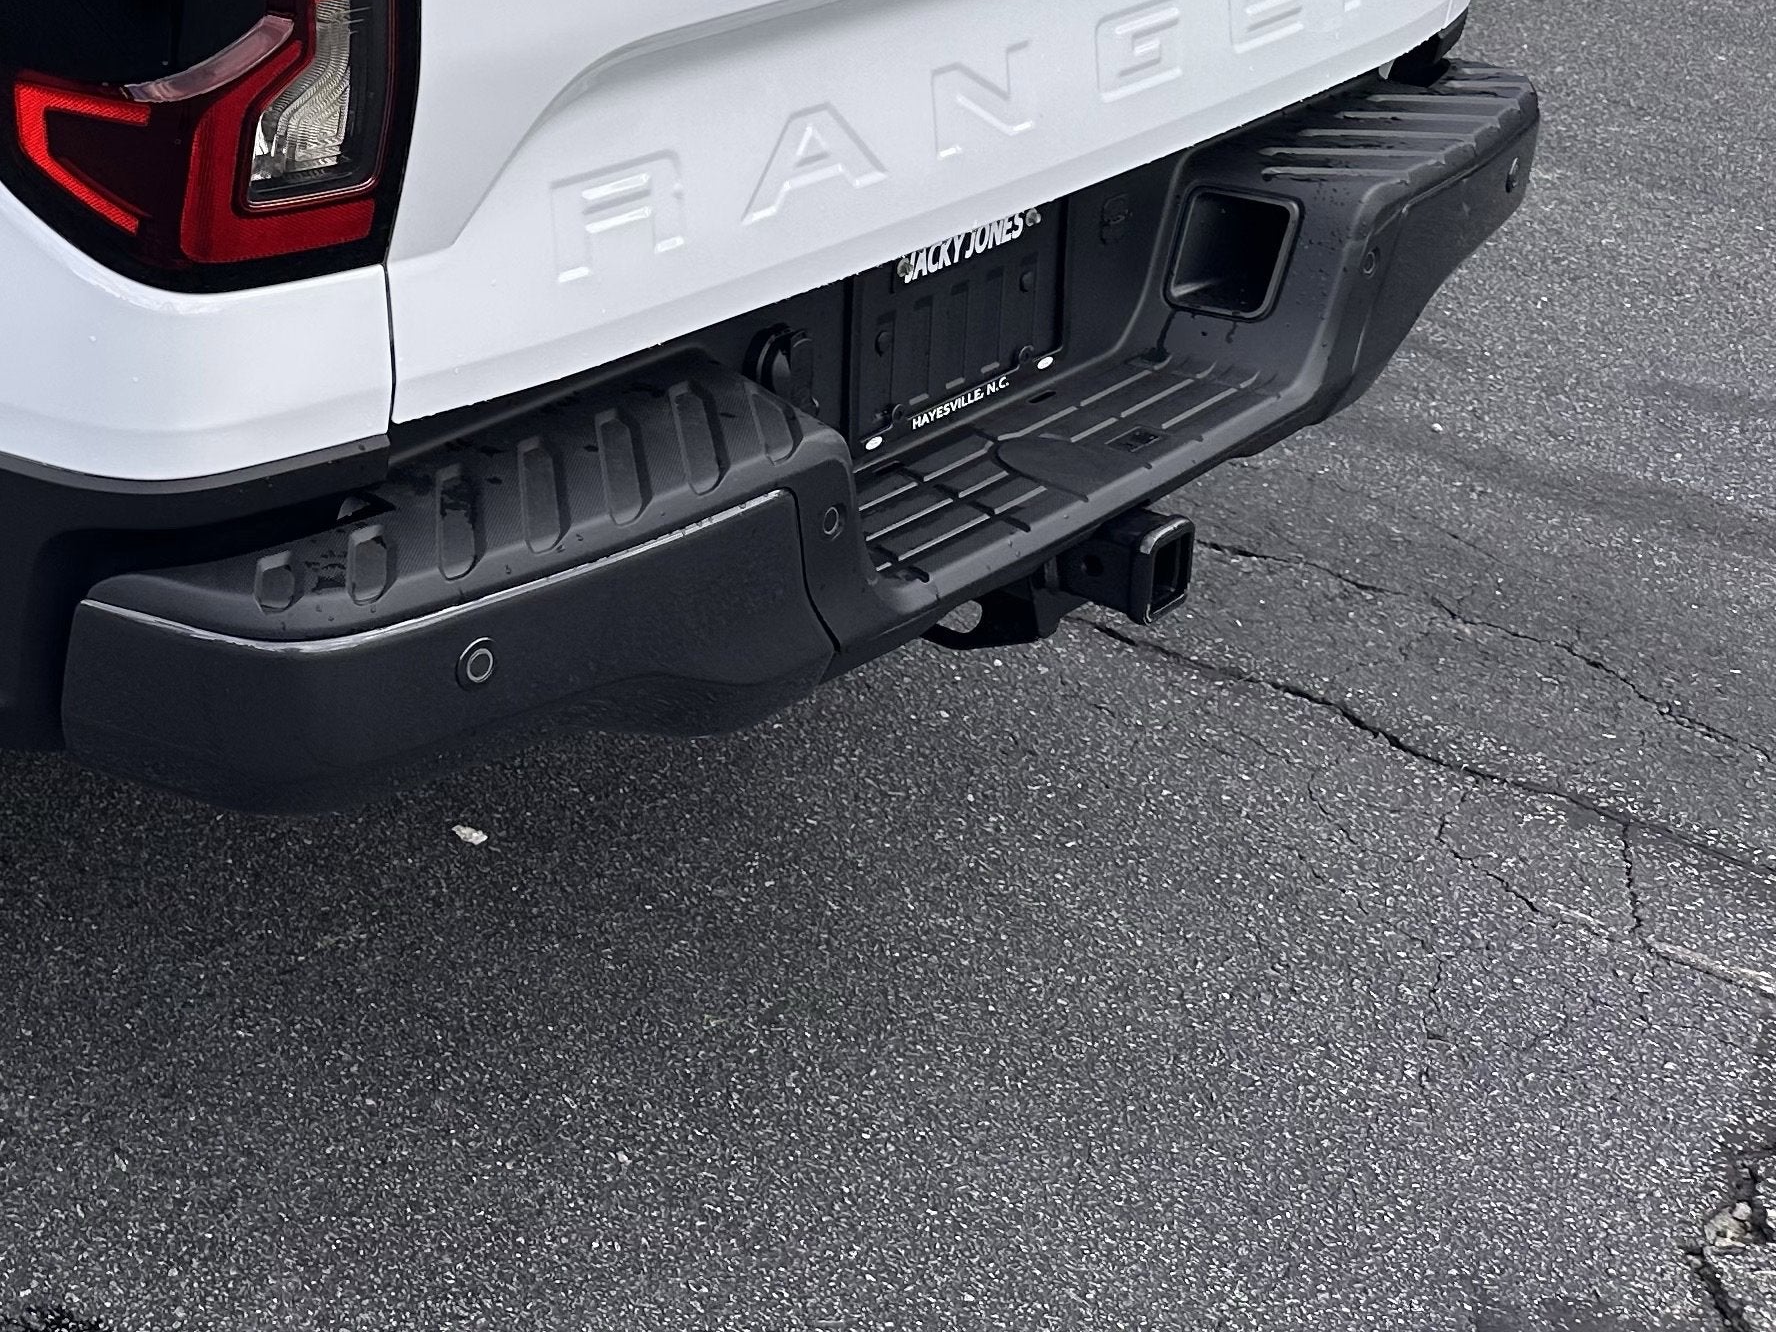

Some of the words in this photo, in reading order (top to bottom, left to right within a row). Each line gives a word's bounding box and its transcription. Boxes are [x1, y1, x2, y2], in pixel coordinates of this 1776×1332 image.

[903, 233, 968, 284] JACKY
[964, 212, 1025, 259] JONES
[986, 376, 1010, 396] N.C.
